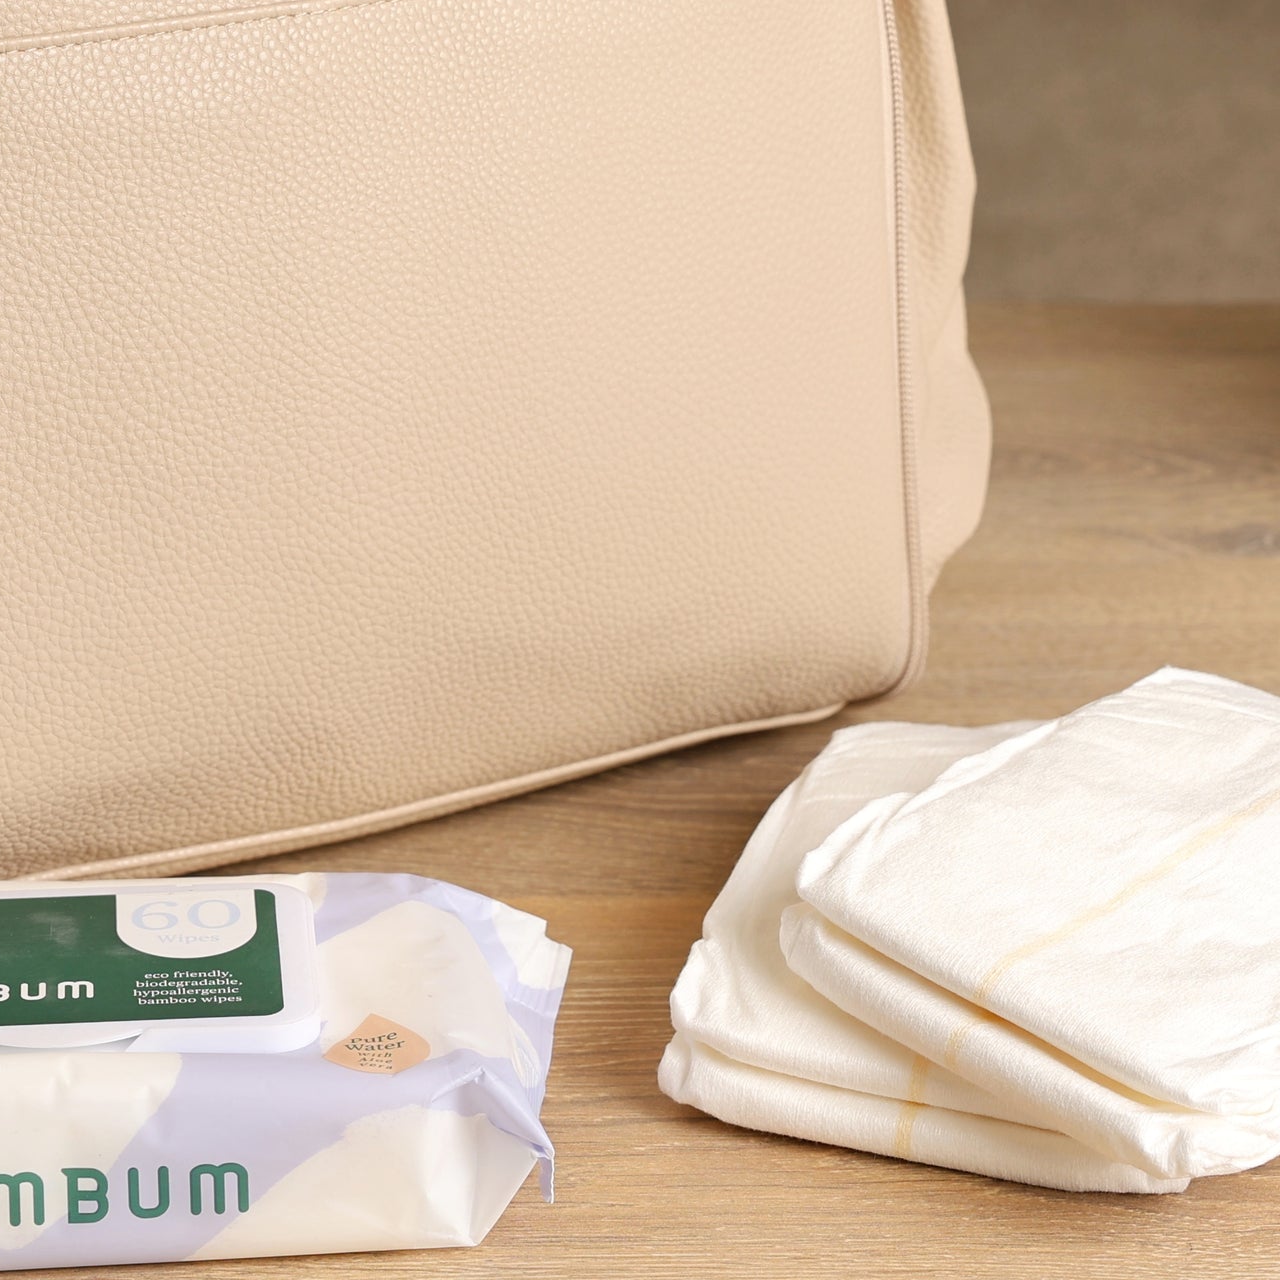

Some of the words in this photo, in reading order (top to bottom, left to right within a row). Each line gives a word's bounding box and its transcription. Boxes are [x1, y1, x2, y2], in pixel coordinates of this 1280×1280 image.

[131, 899, 241, 931] 60
[158, 933, 221, 945] Wipes
[173, 969, 233, 979] friendly,
[135, 977, 243, 989] biodegradable,
[132, 986, 240, 998] hypoallergenic
[138, 996, 197, 1006] bamboo
[200, 995, 243, 1004] wipes
[344, 1040, 406, 1052] Water
